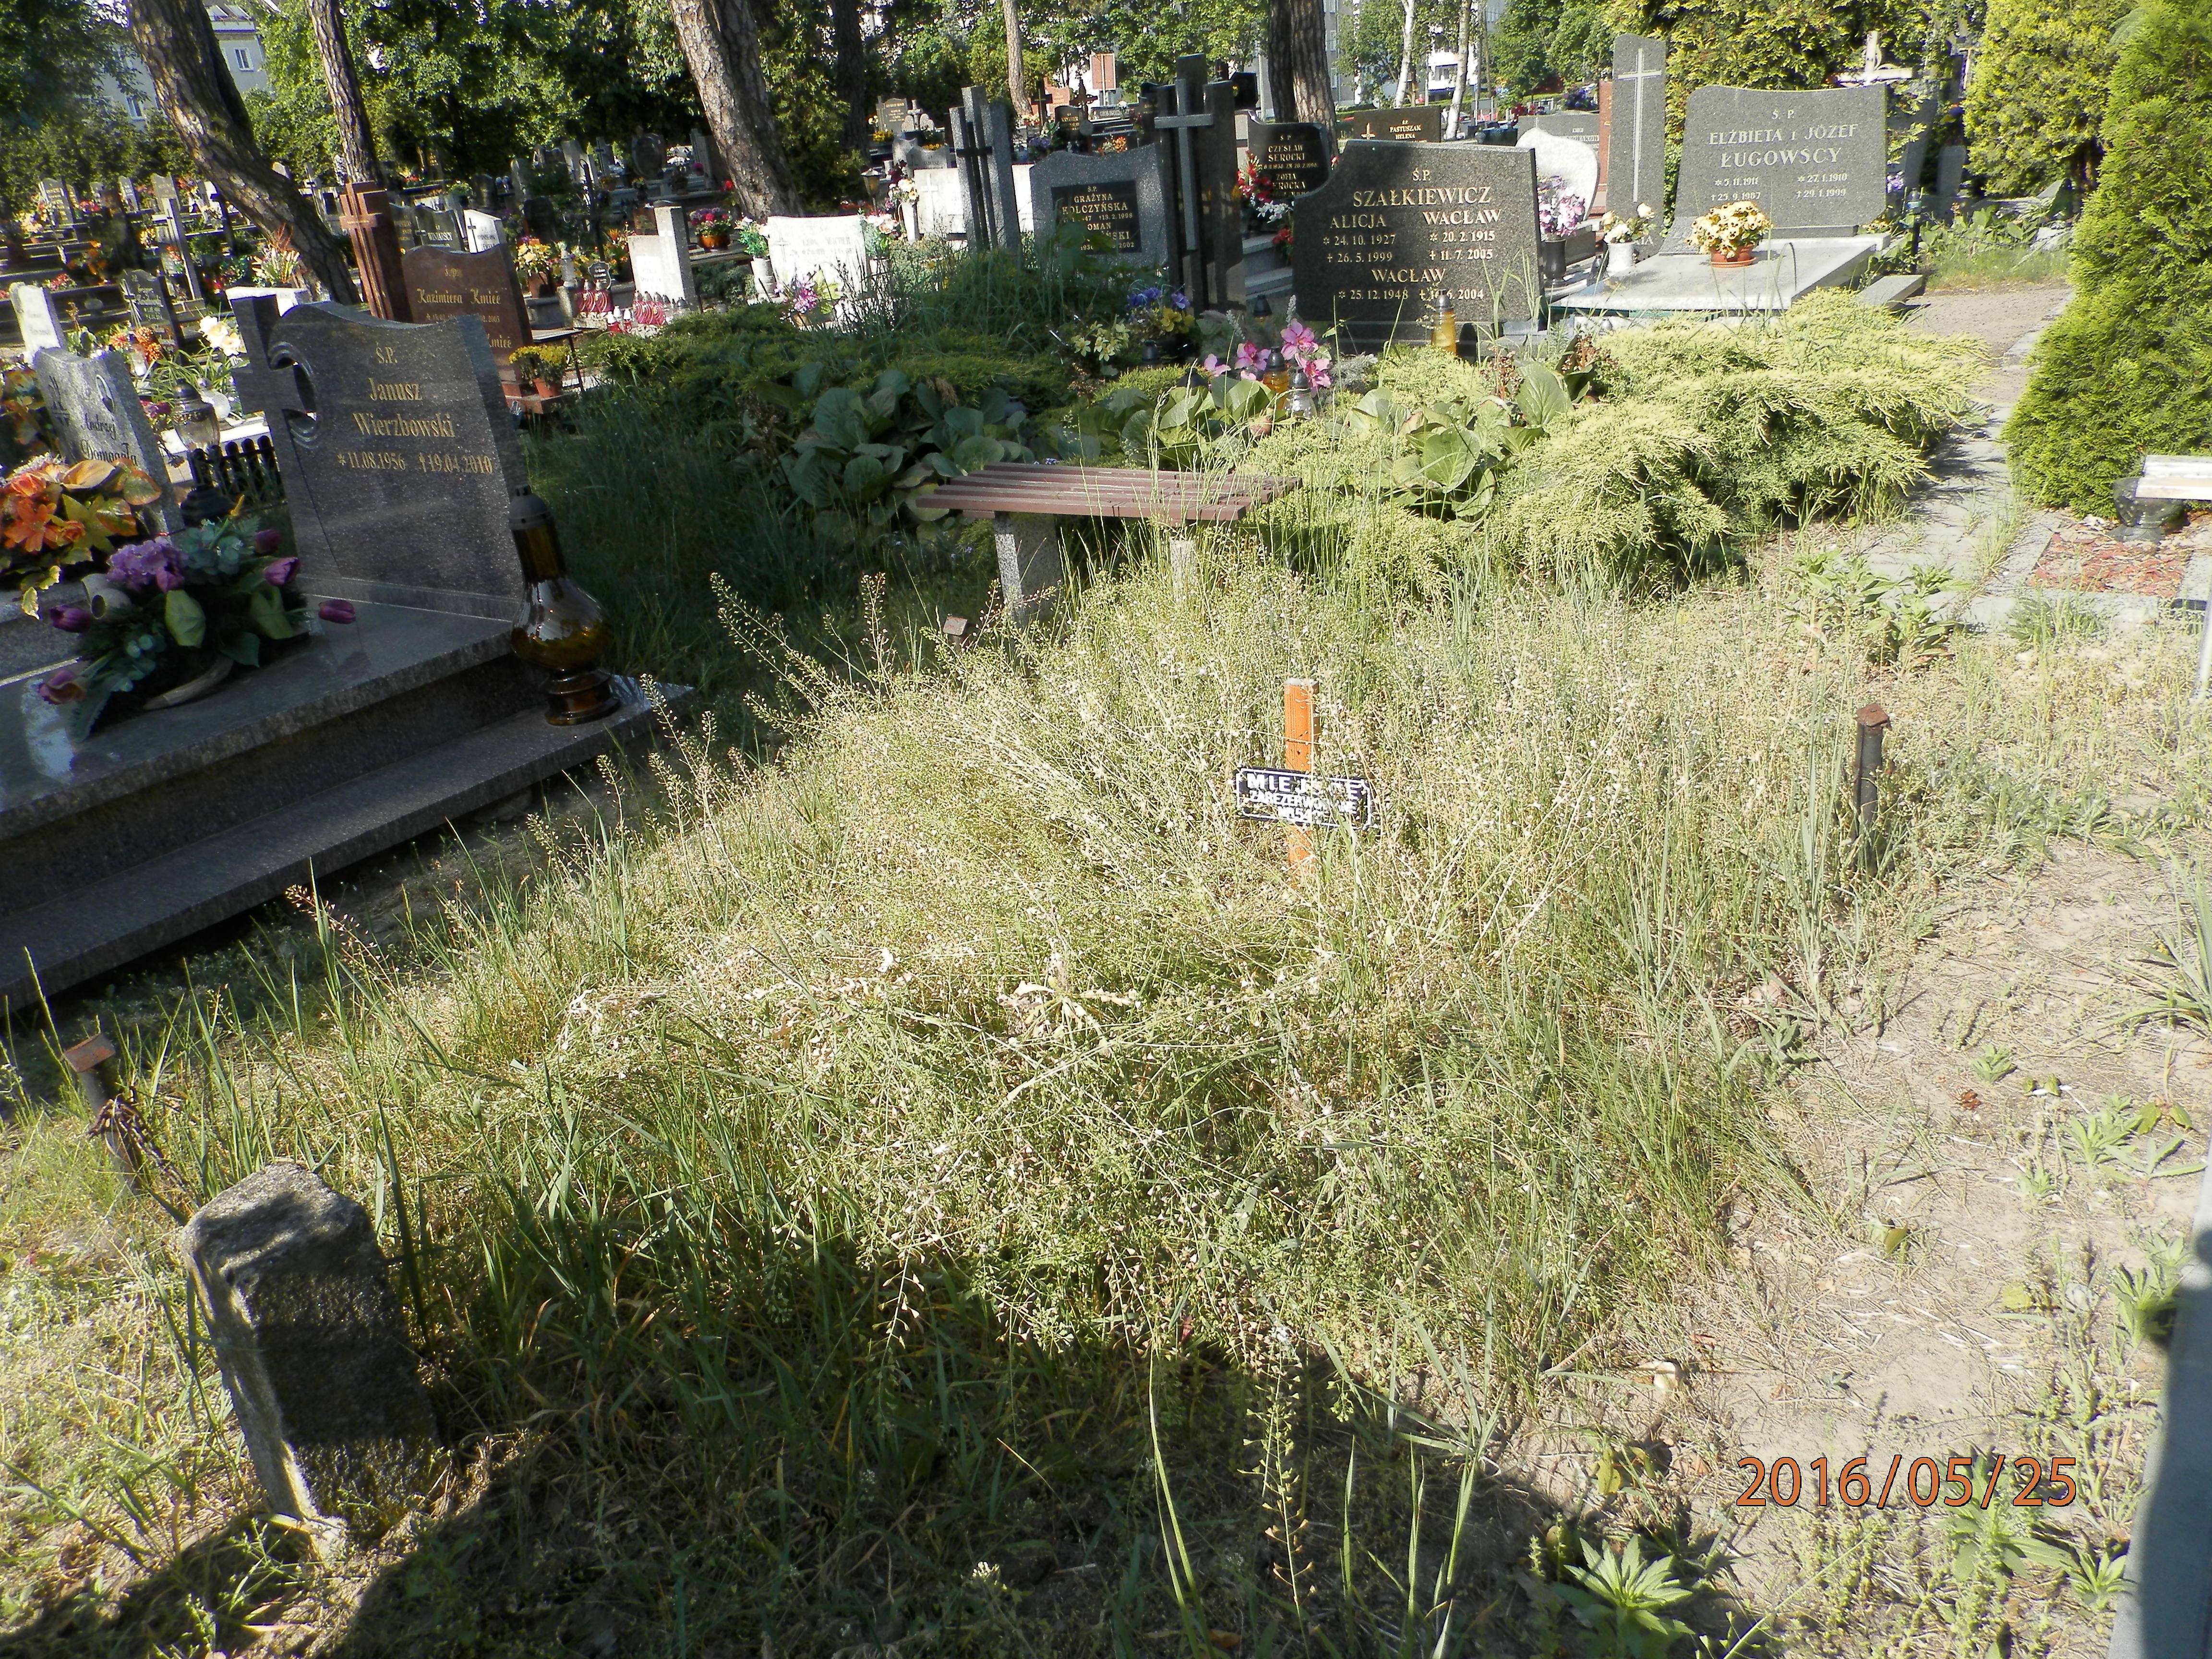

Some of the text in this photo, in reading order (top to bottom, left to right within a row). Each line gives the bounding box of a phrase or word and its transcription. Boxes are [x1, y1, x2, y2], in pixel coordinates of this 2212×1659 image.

[1390, 125, 1421, 133] PASTUSZAK
[1709, 129, 1783, 145] ELŻBIETA
[1804, 123, 1859, 141] JÓZEF
[1268, 153, 1305, 162] SEROCKI
[1721, 147, 1842, 168] ŁUGOWSCY
[1273, 181, 1306, 190] EROCKA
[1074, 193, 1113, 203] GRAŻYNA
[1353, 186, 1491, 207] SZAŁKIEWICZ
[1329, 214, 1387, 229] ALICJA
[1422, 209, 1502, 225] WACŁAW
[1087, 222, 1111, 231] OMAN
[1370, 234, 1397, 245] 1927
[1470, 230, 1495, 241] 1915
[1368, 252, 1393, 262] 1999
[1467, 249, 1493, 260] 2005
[1371, 268, 1446, 283] WACŁAW
[417, 288, 463, 304] Kazimiera
[1458, 289, 1484, 300] 2004
[368, 377, 423, 401] Janusz
[81, 412, 116, 440] Andrzej
[352, 412, 456, 438] Wierzbowski
